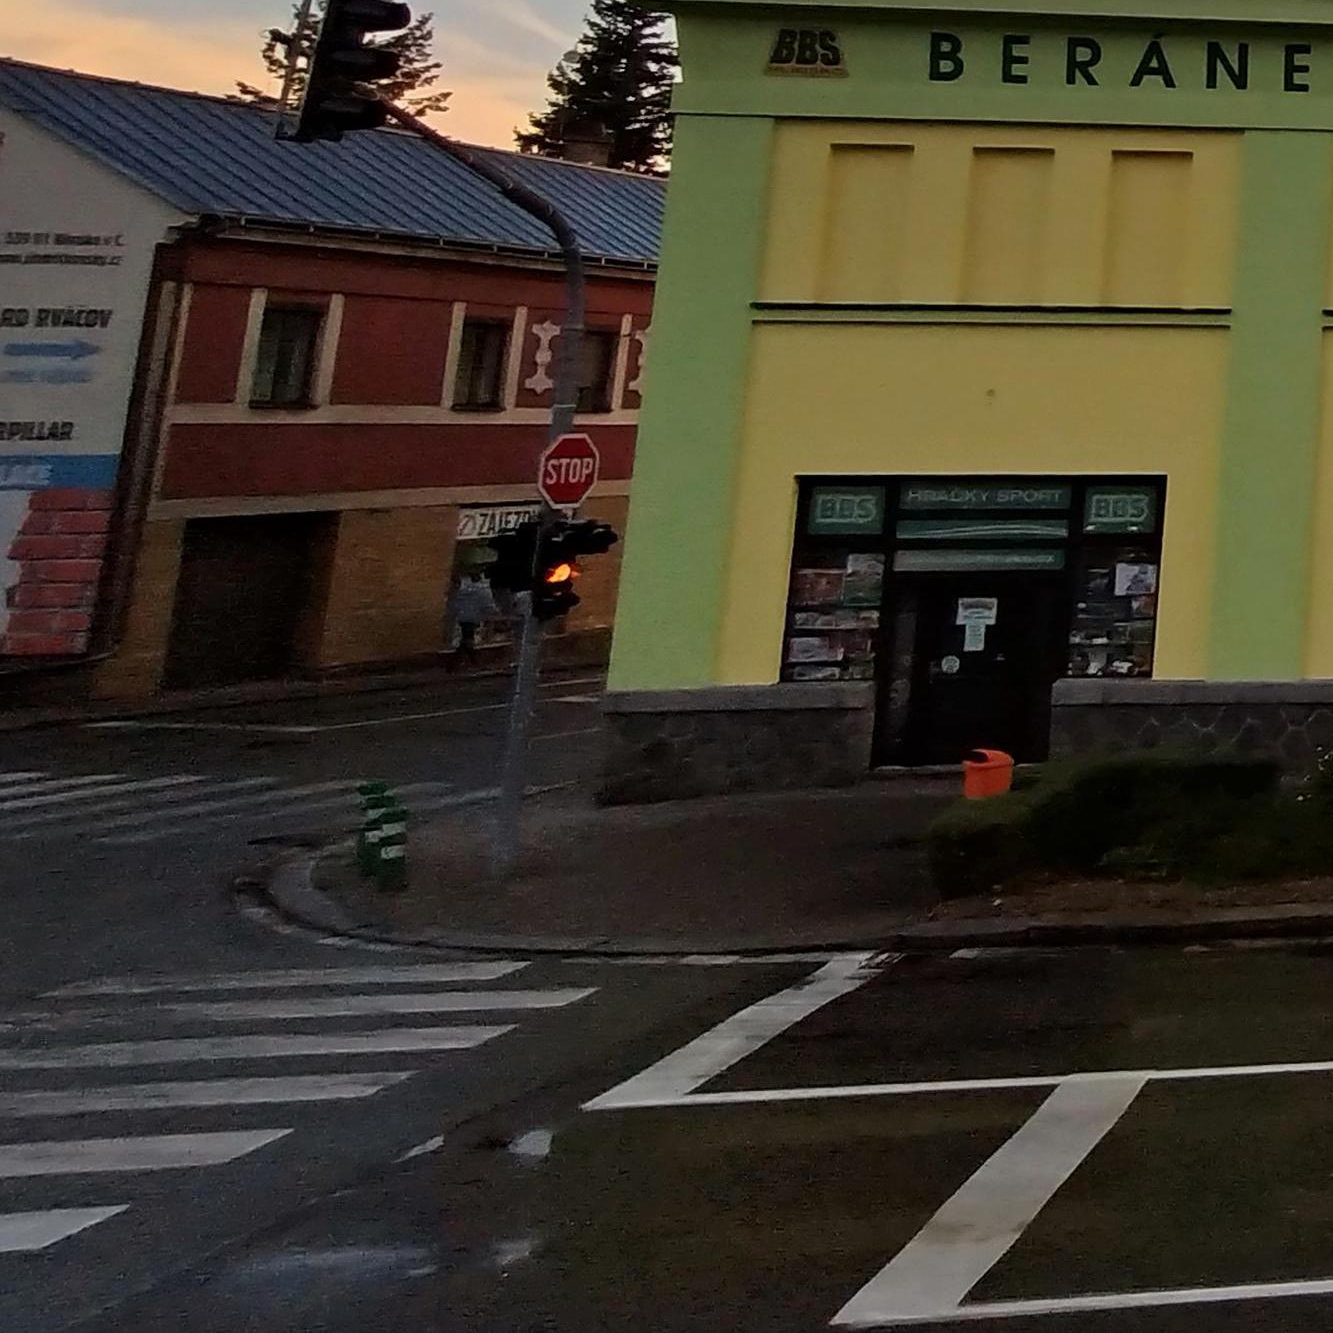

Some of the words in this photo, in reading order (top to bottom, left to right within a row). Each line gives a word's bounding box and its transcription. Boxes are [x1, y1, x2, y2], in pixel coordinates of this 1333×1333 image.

[769, 28, 841, 66] BBS
[546, 457, 593, 485] STOP
[997, 489, 1064, 503] SPORT
